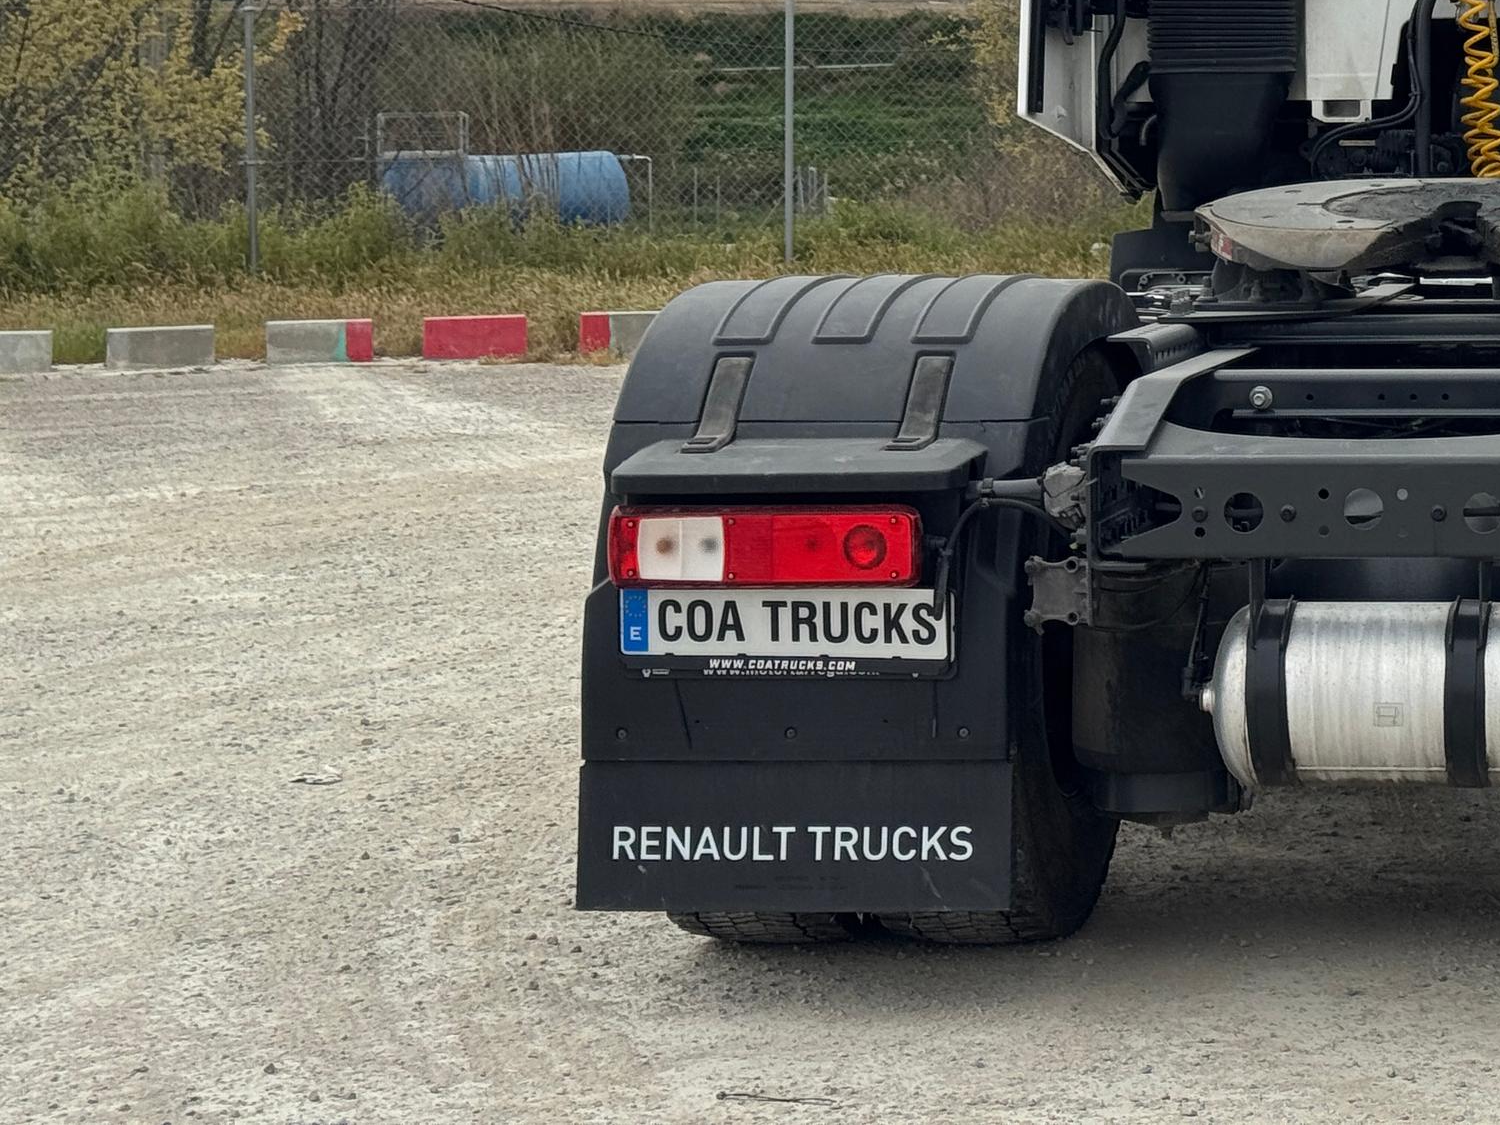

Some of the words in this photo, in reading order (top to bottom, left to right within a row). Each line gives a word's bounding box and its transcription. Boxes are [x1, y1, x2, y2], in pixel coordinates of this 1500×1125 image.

[629, 626, 642, 641] E
[658, 598, 746, 643] COA
[762, 600, 937, 646] TRUCKS
[709, 658, 857, 671] WWW.COATRUCKS.COM
[612, 825, 797, 861] RENAULT
[807, 825, 974, 862] TRUCKS
